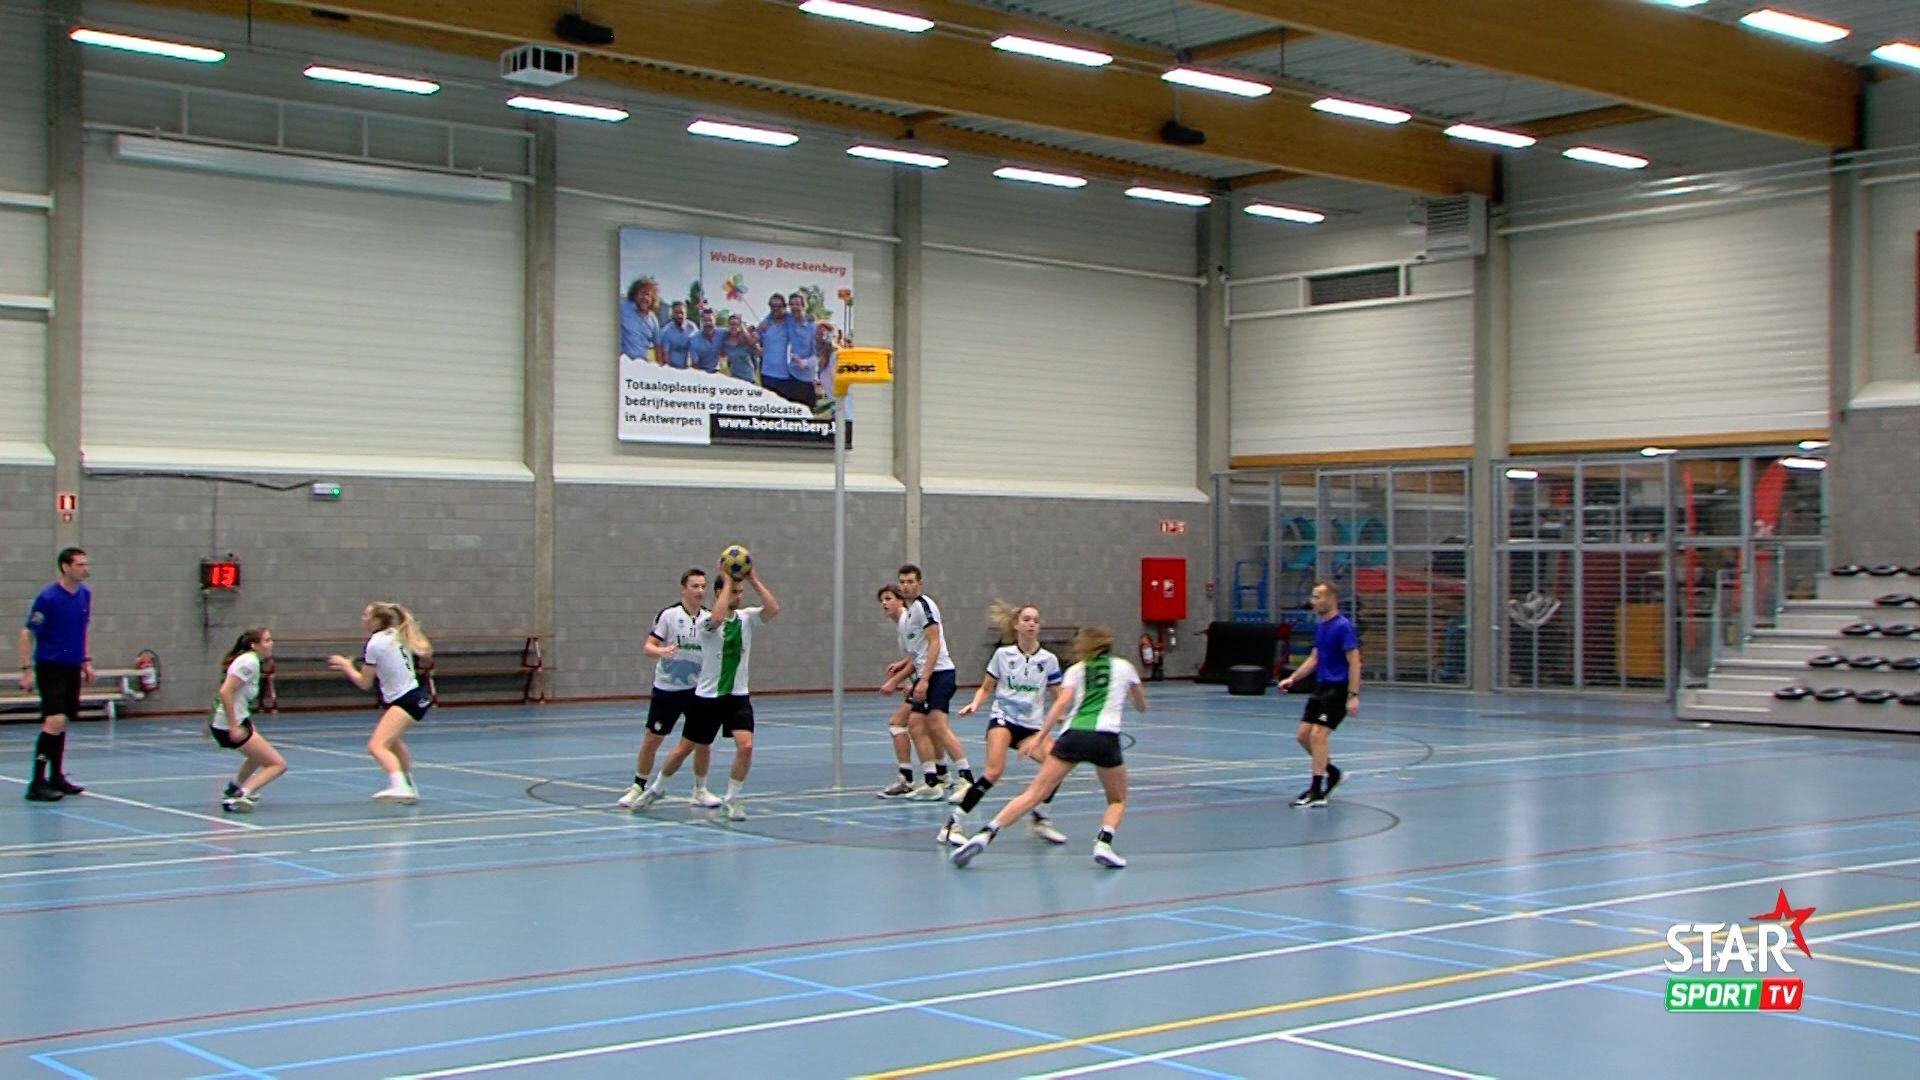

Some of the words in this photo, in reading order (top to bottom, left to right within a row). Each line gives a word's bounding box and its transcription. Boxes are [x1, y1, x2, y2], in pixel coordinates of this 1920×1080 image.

[710, 251, 756, 265] Welkom
[758, 259, 773, 270] op
[776, 257, 847, 276] Boeckenberg
[625, 379, 716, 397] Totaaloplossing
[625, 396, 705, 410] bedrijfsevents
[709, 403, 723, 413] op
[726, 404, 746, 412] een
[748, 403, 802, 415] toplocatie
[625, 412, 636, 422] in
[640, 413, 702, 427] Antwerpen
